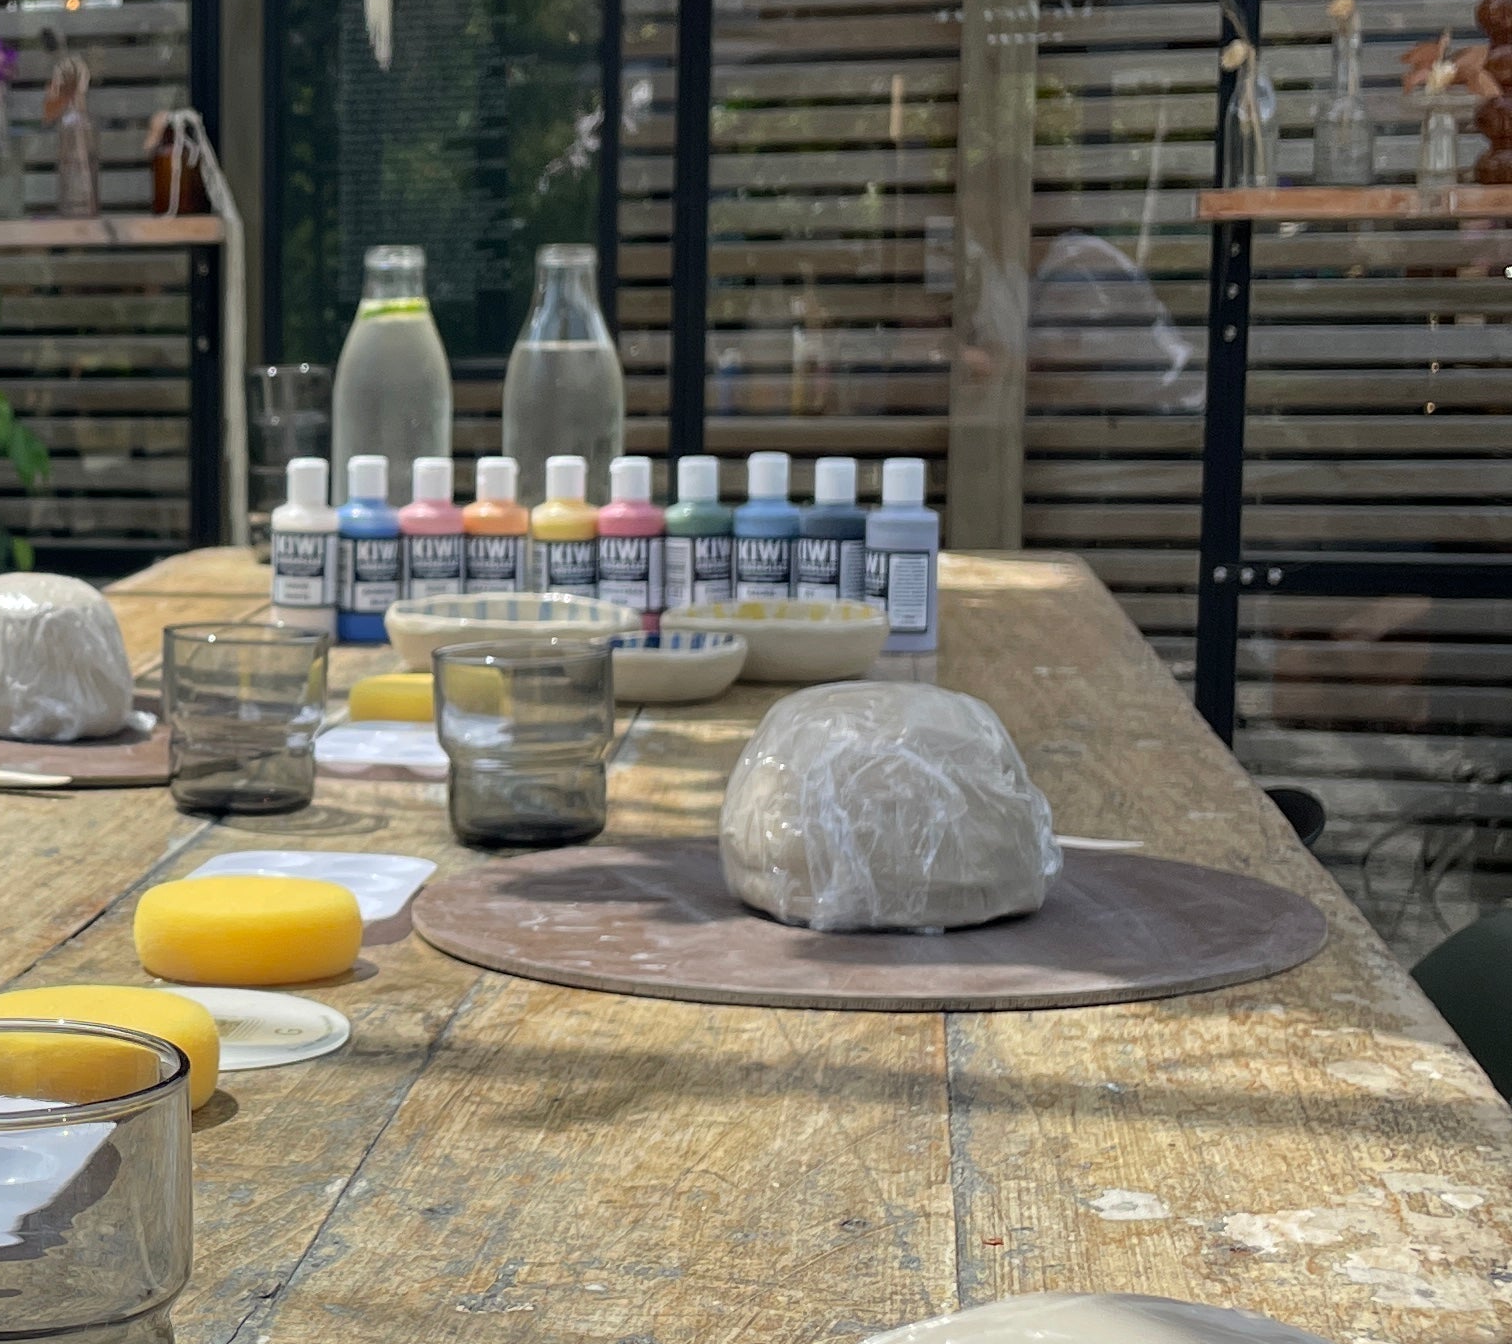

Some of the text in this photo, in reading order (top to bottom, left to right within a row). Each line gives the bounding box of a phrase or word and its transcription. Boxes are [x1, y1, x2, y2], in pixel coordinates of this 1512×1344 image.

[277, 535, 325, 556] KIWI
[411, 537, 458, 558] KIWI
[599, 537, 647, 559] KIWI
[738, 538, 788, 560] KIWI
